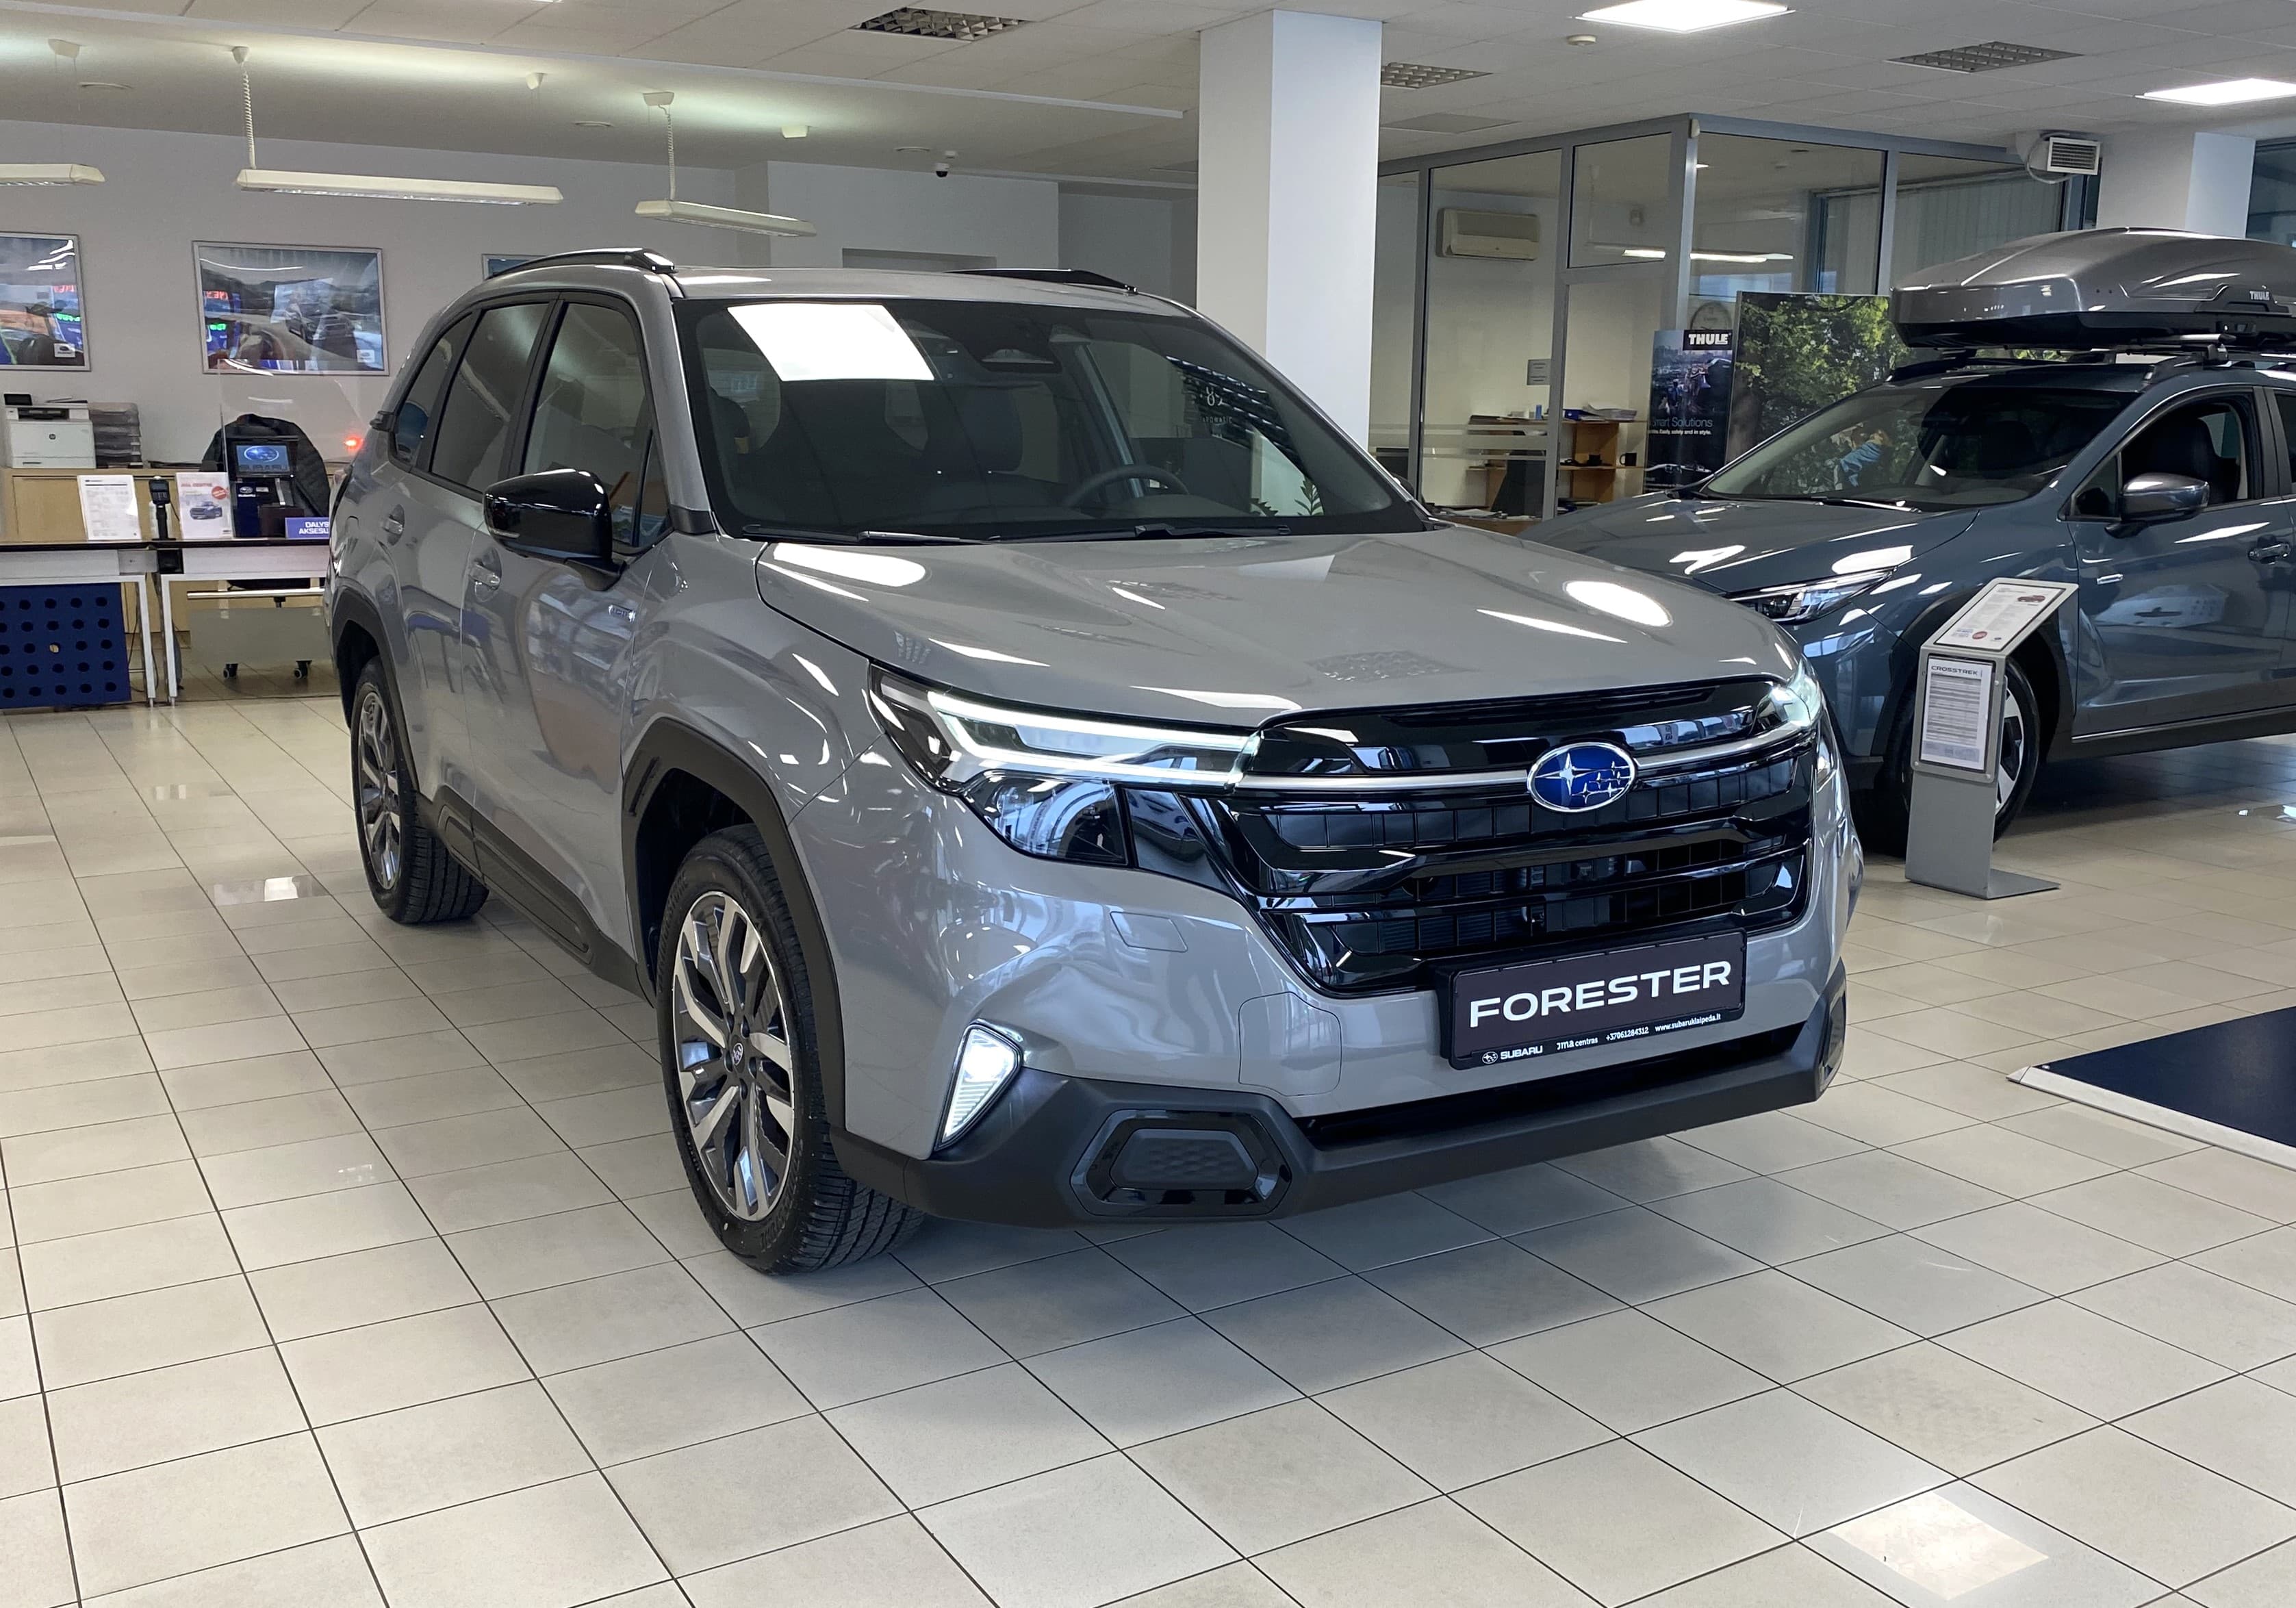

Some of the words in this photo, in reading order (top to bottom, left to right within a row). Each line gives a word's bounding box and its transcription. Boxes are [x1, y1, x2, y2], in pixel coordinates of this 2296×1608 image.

[2249, 291, 2270, 301] THULE
[1688, 333, 1729, 345] THULE
[1672, 416, 1713, 428] Solutions
[1930, 665, 1978, 676] CROSSTREK
[1469, 960, 1732, 1028] FORESTER
[1500, 1045, 1544, 1060] SUBARU
[1575, 1036, 1598, 1047] centras
[1655, 1012, 1721, 1032] www.subaruklaipeda.lt
